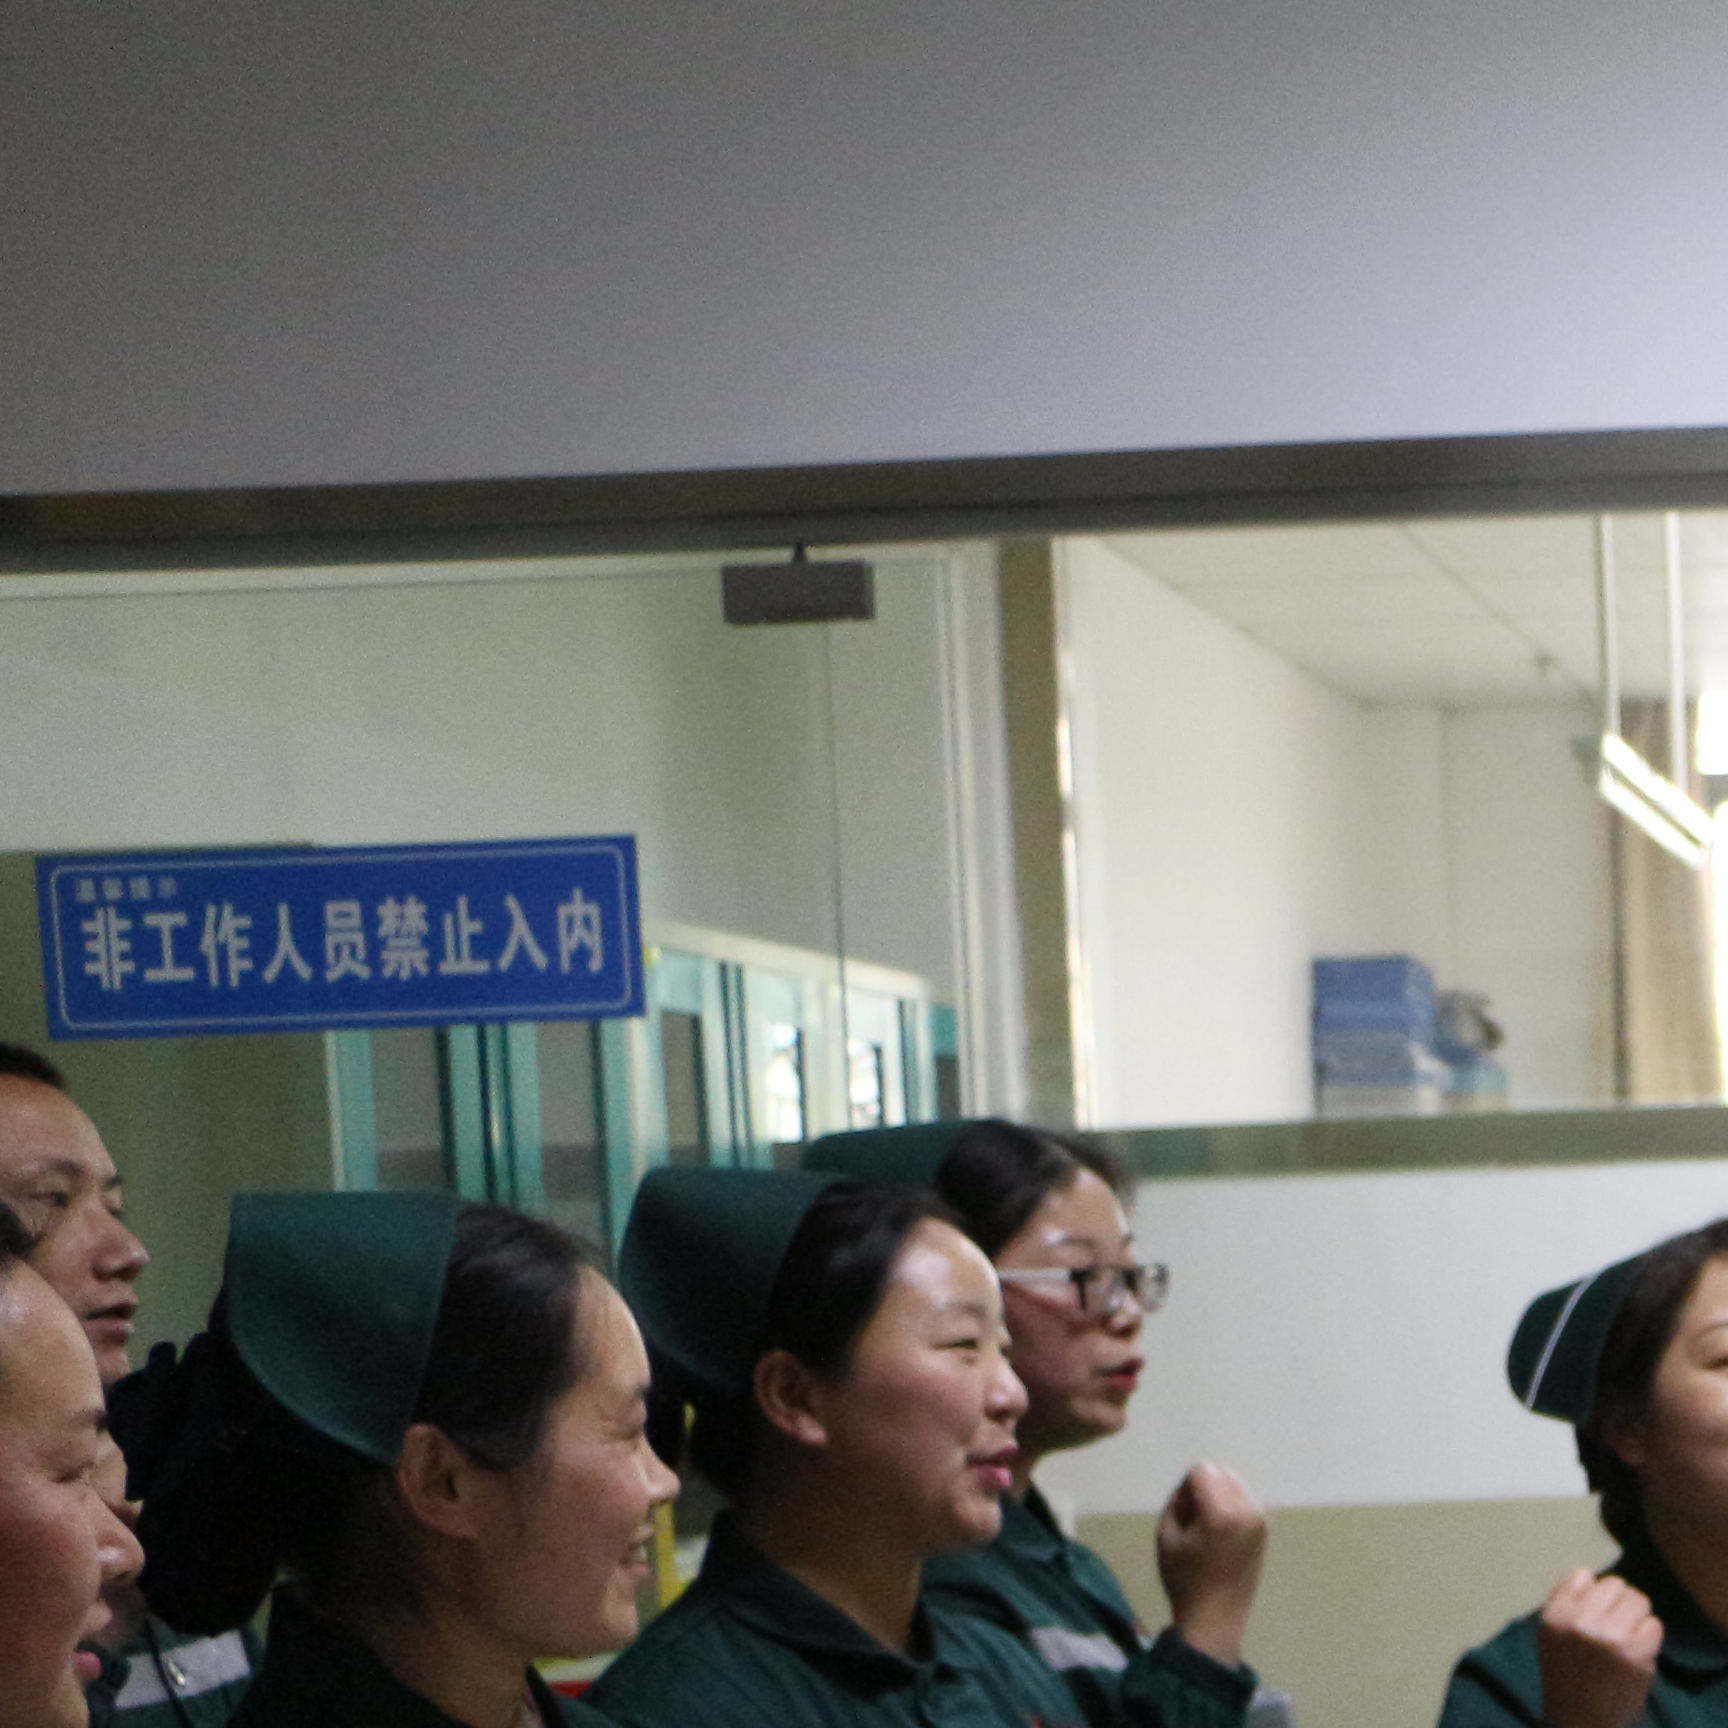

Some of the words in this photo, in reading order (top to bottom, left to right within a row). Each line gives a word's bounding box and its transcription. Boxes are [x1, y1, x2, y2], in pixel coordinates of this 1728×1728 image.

[81, 886, 606, 990] 非工作人员禁止入内
